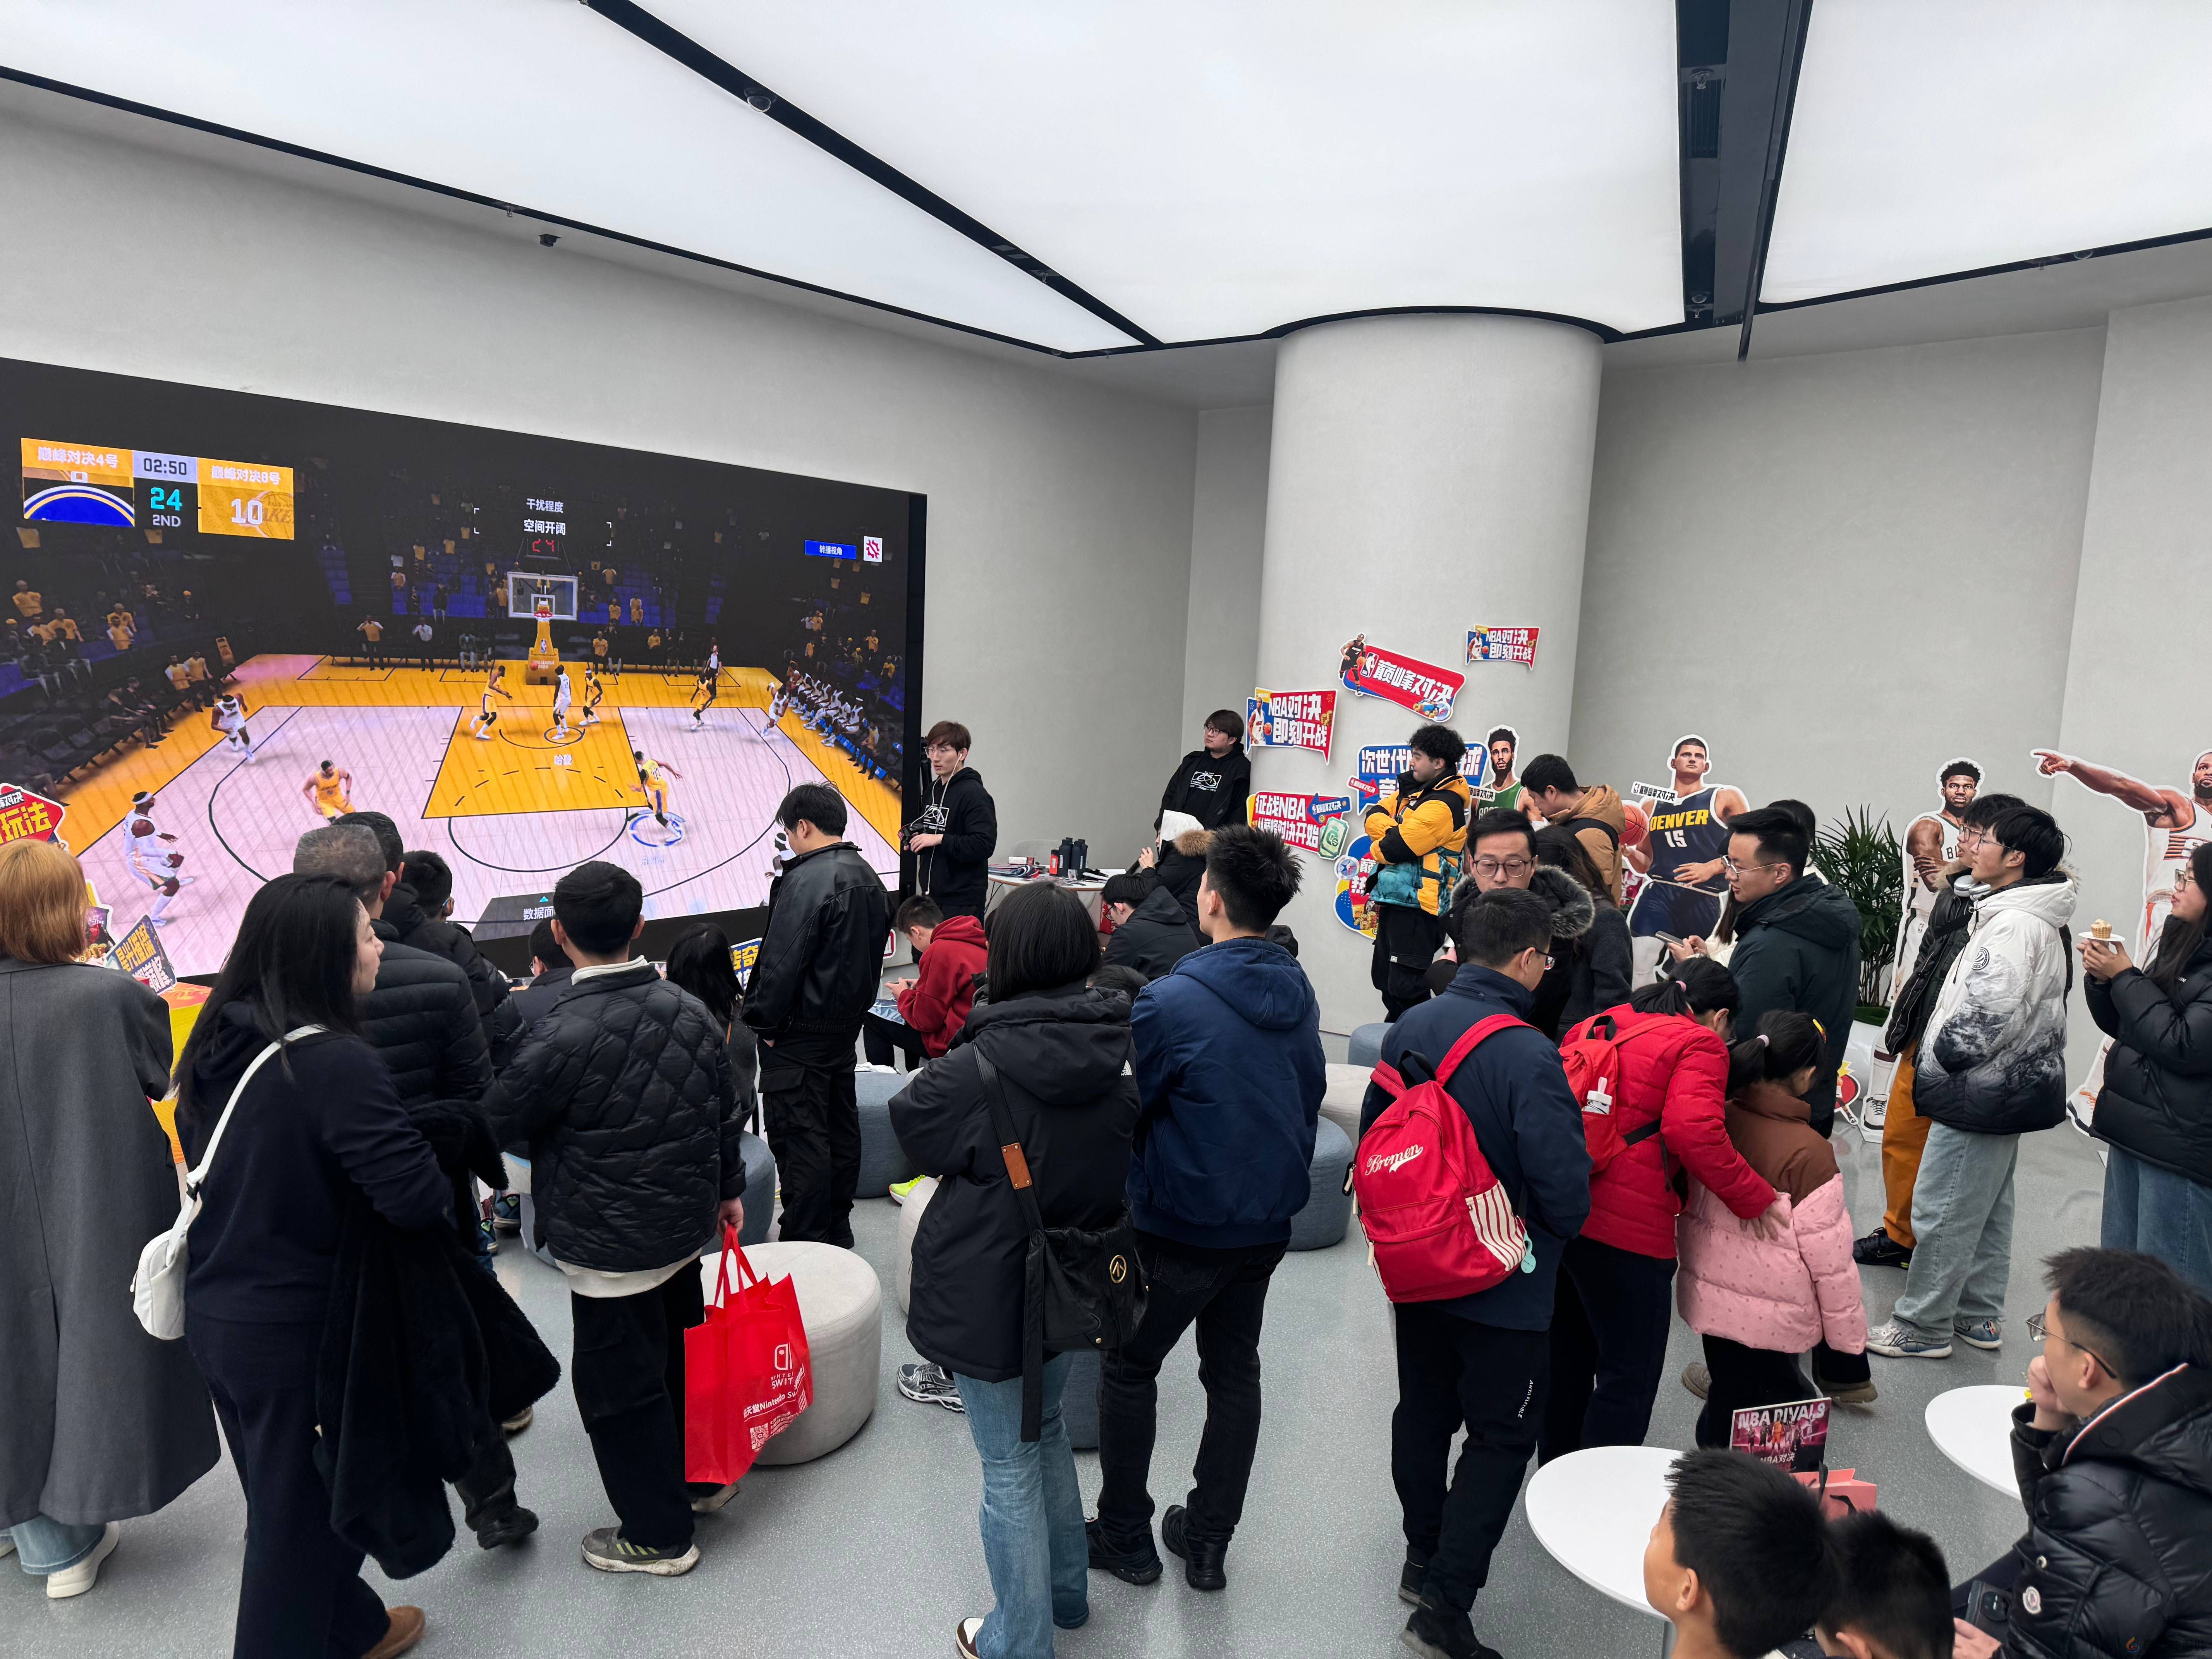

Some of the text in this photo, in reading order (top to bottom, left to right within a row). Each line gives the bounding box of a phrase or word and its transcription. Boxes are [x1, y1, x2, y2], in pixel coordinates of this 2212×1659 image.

[38, 447, 118, 468] 巅峰对决4号
[143, 458, 187, 476] 02:50
[211, 466, 280, 485] 巅峰对决8号
[150, 487, 182, 511] 24
[526, 498, 563, 513] 干扰程度
[152, 514, 181, 527] 2ND
[231, 498, 263, 525] 10
[524, 519, 566, 535] 空间开阔
[819, 545, 842, 555] 转播视角
[1486, 629, 1529, 645] NBA对决
[1489, 642, 1532, 660] 即刻开战
[1373, 659, 1454, 704] 巅峰对决
[1268, 694, 1322, 721] NBA对决
[1273, 717, 1327, 747] 即刻开战
[1255, 794, 1307, 821] 征战NBA
[1650, 809, 1709, 832] DENVER
[1664, 830, 1688, 848] 15
[523, 906, 556, 921] 数据面
[1365, 1144, 1423, 1176] Bromen
[1738, 1410, 1771, 1429] NBA
